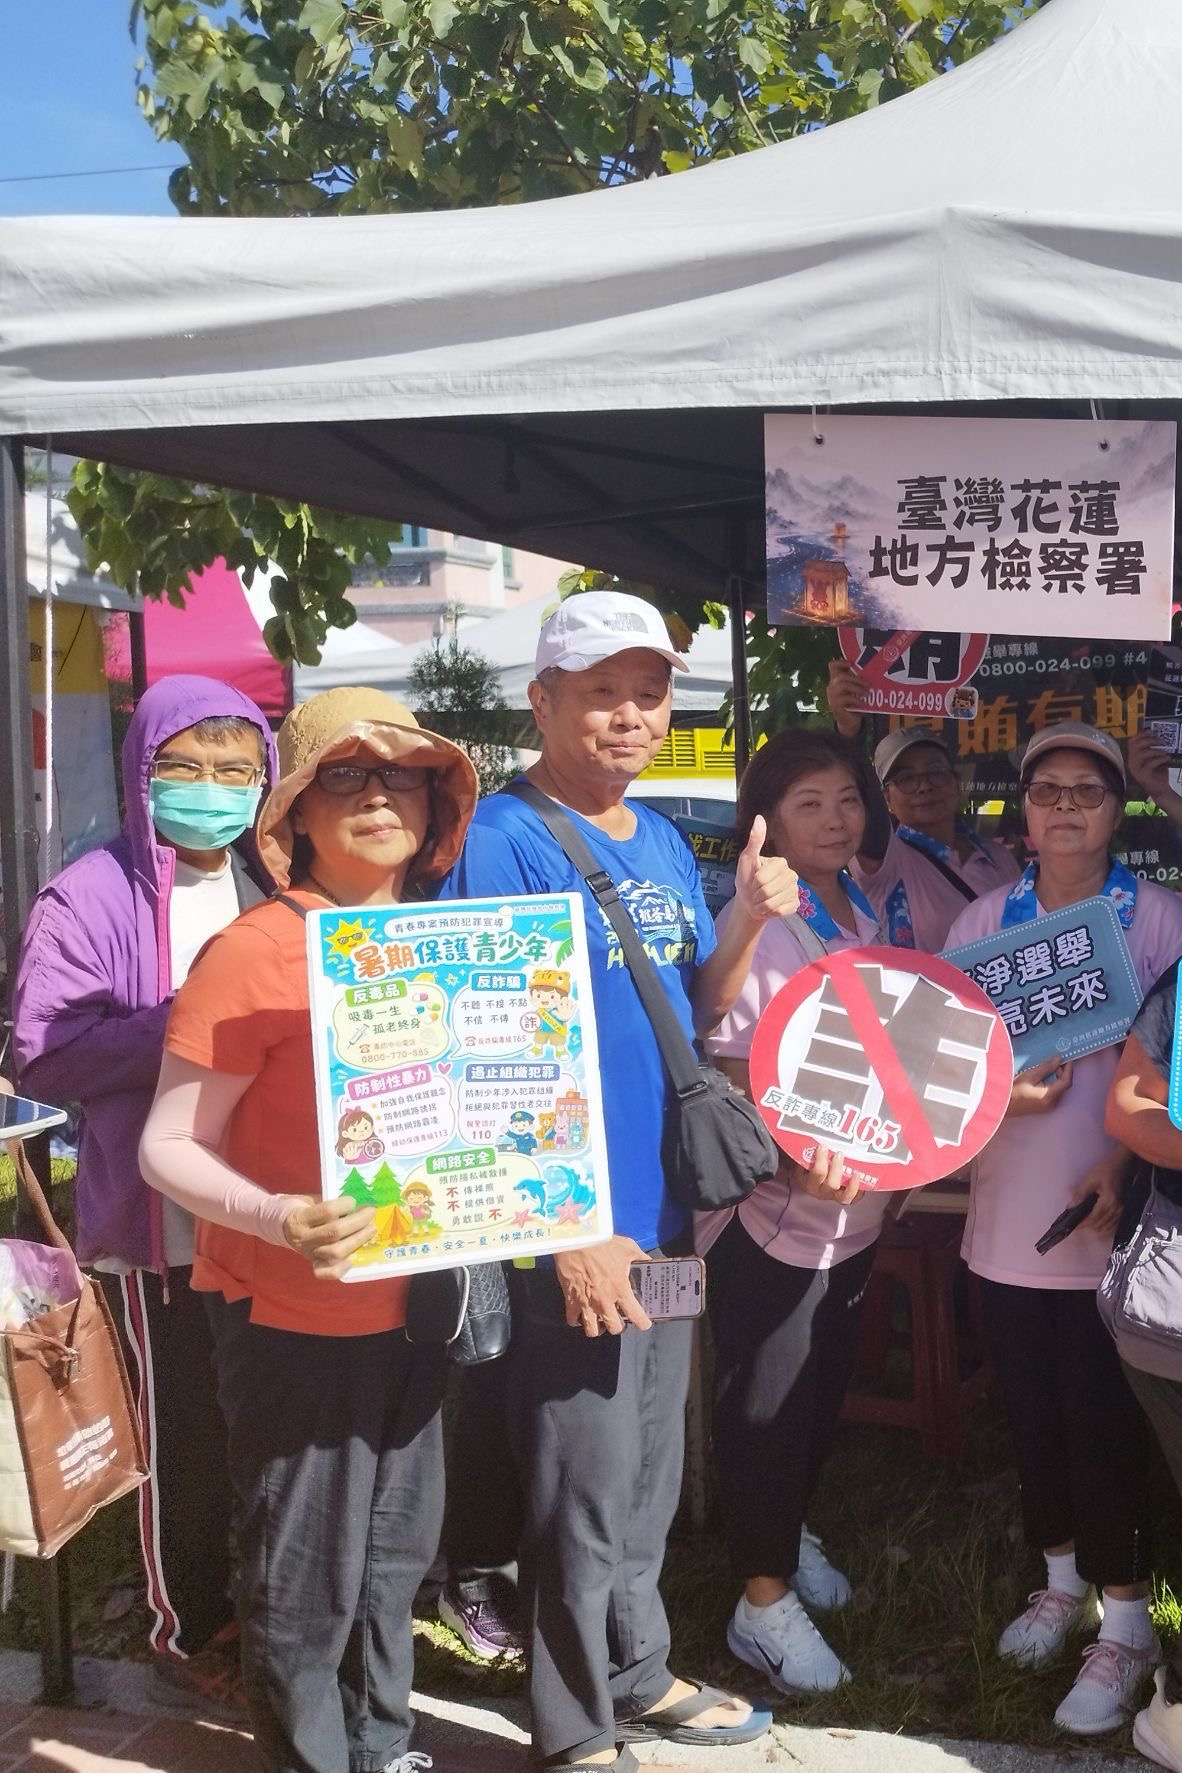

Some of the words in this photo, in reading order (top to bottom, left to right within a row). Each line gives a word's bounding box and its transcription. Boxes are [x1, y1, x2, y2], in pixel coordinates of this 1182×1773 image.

[897, 475, 1120, 536] 臺灣花蓮
[868, 534, 1147, 595] 地方檢察署
[979, 654, 1115, 677] 0800-024-099
[1123, 651, 1147, 665] #4
[864, 688, 943, 712] 00-024-099
[395, 917, 503, 933] 青春專案預防犯罪宣導
[354, 931, 547, 978] 暑期保護青少年
[965, 926, 1093, 995] 淨選舉
[477, 975, 521, 989] 反詐騙
[353, 983, 400, 1004] 反毒品
[486, 999, 504, 1008] 不接
[349, 1005, 401, 1021] 吸毒一生
[464, 1015, 482, 1025] 不信
[490, 1014, 509, 1024] 不傳
[373, 1018, 420, 1034] 孤老終身
[471, 1065, 554, 1079] 遏止組織犯罪
[354, 1068, 427, 1097] 防制性暴力
[466, 1086, 553, 1098] 防制少年涉入犯罪組織
[472, 1130, 491, 1139] 110
[432, 1152, 491, 1171] 網路安全
[446, 1187, 459, 1198] 不
[448, 1200, 460, 1212] 不
[488, 1208, 502, 1221] 不
